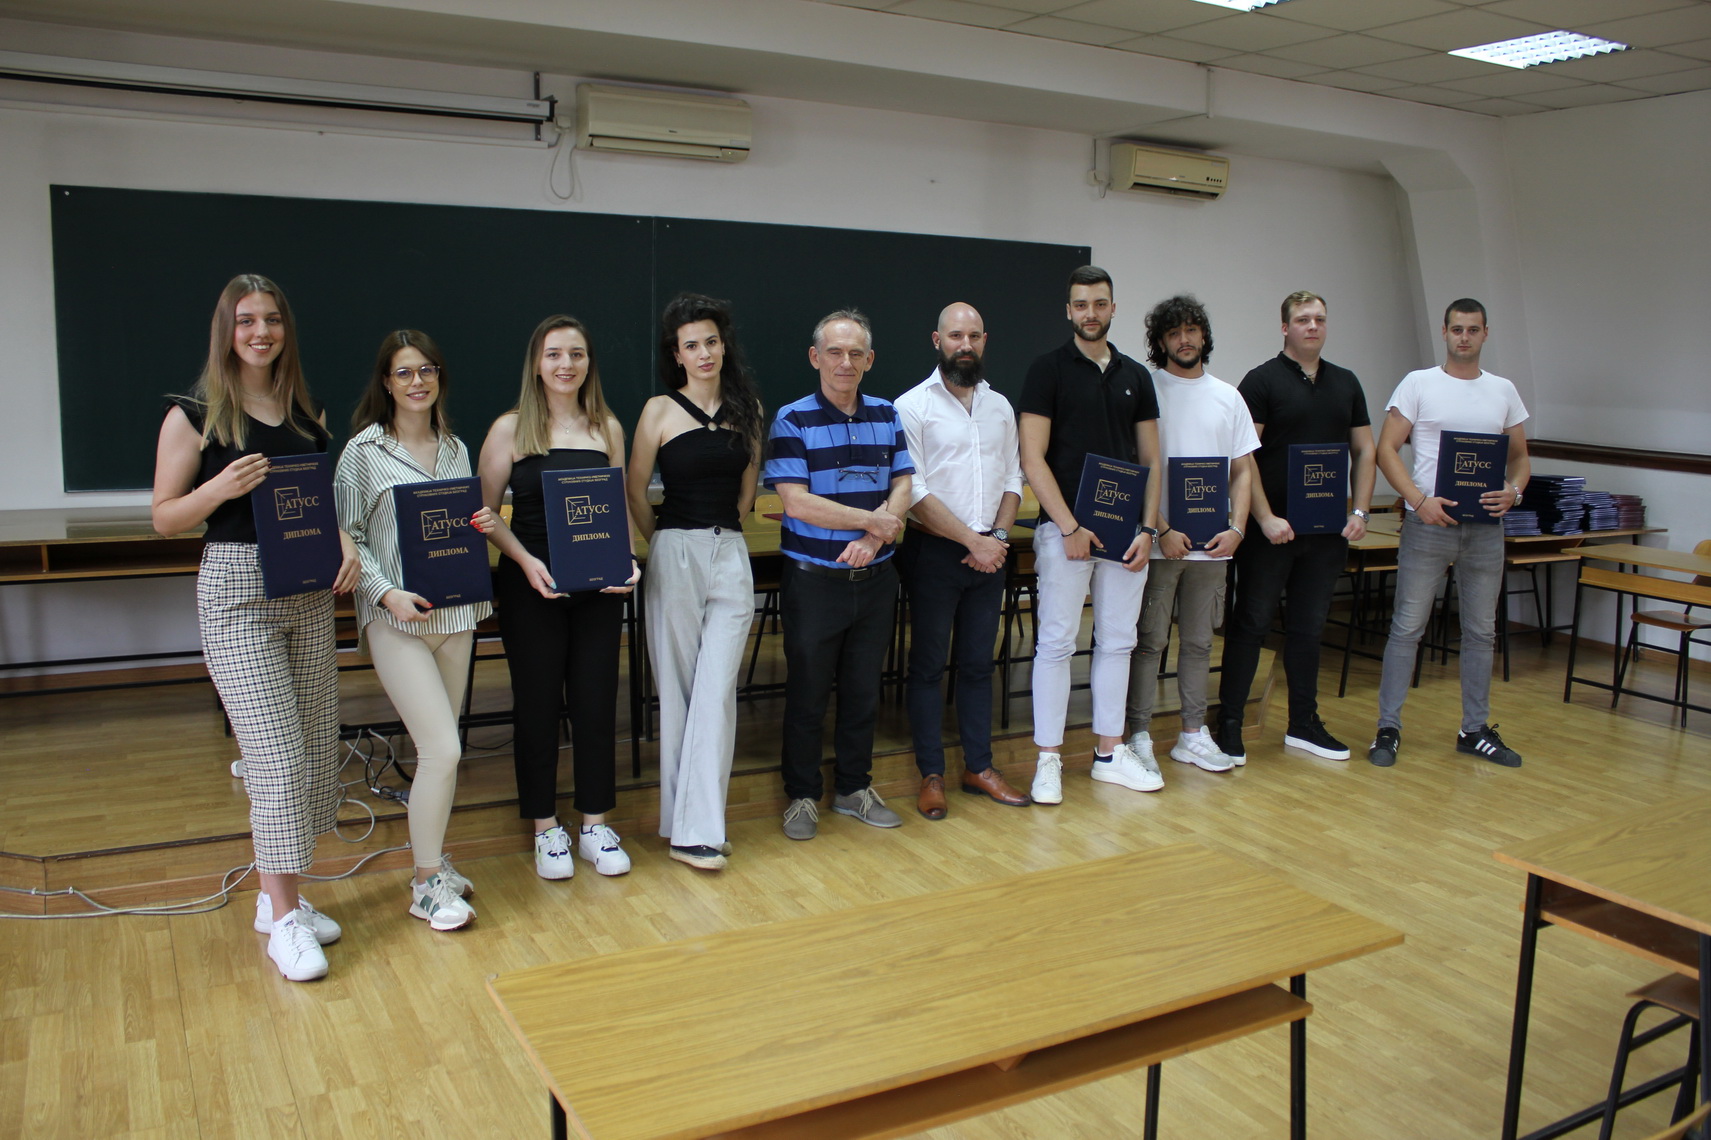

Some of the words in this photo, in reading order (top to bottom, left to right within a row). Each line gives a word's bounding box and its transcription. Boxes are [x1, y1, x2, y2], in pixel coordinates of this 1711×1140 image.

[1462, 461, 1492, 469] АТУСС
[1311, 471, 1336, 479] АТУСС
[1192, 485, 1217, 493] АТУСС
[1103, 489, 1131, 502] АТУСС
[285, 496, 320, 510] АТУСС
[575, 504, 610, 516] АТУСС
[1093, 510, 1124, 522] ДИПЛОМА
[432, 517, 468, 530] АТУСС
[284, 528, 321, 540] ДИПЛОМА
[572, 532, 610, 542] ДИПЛОМА
[428, 546, 469, 559] ДИПЛОМА
